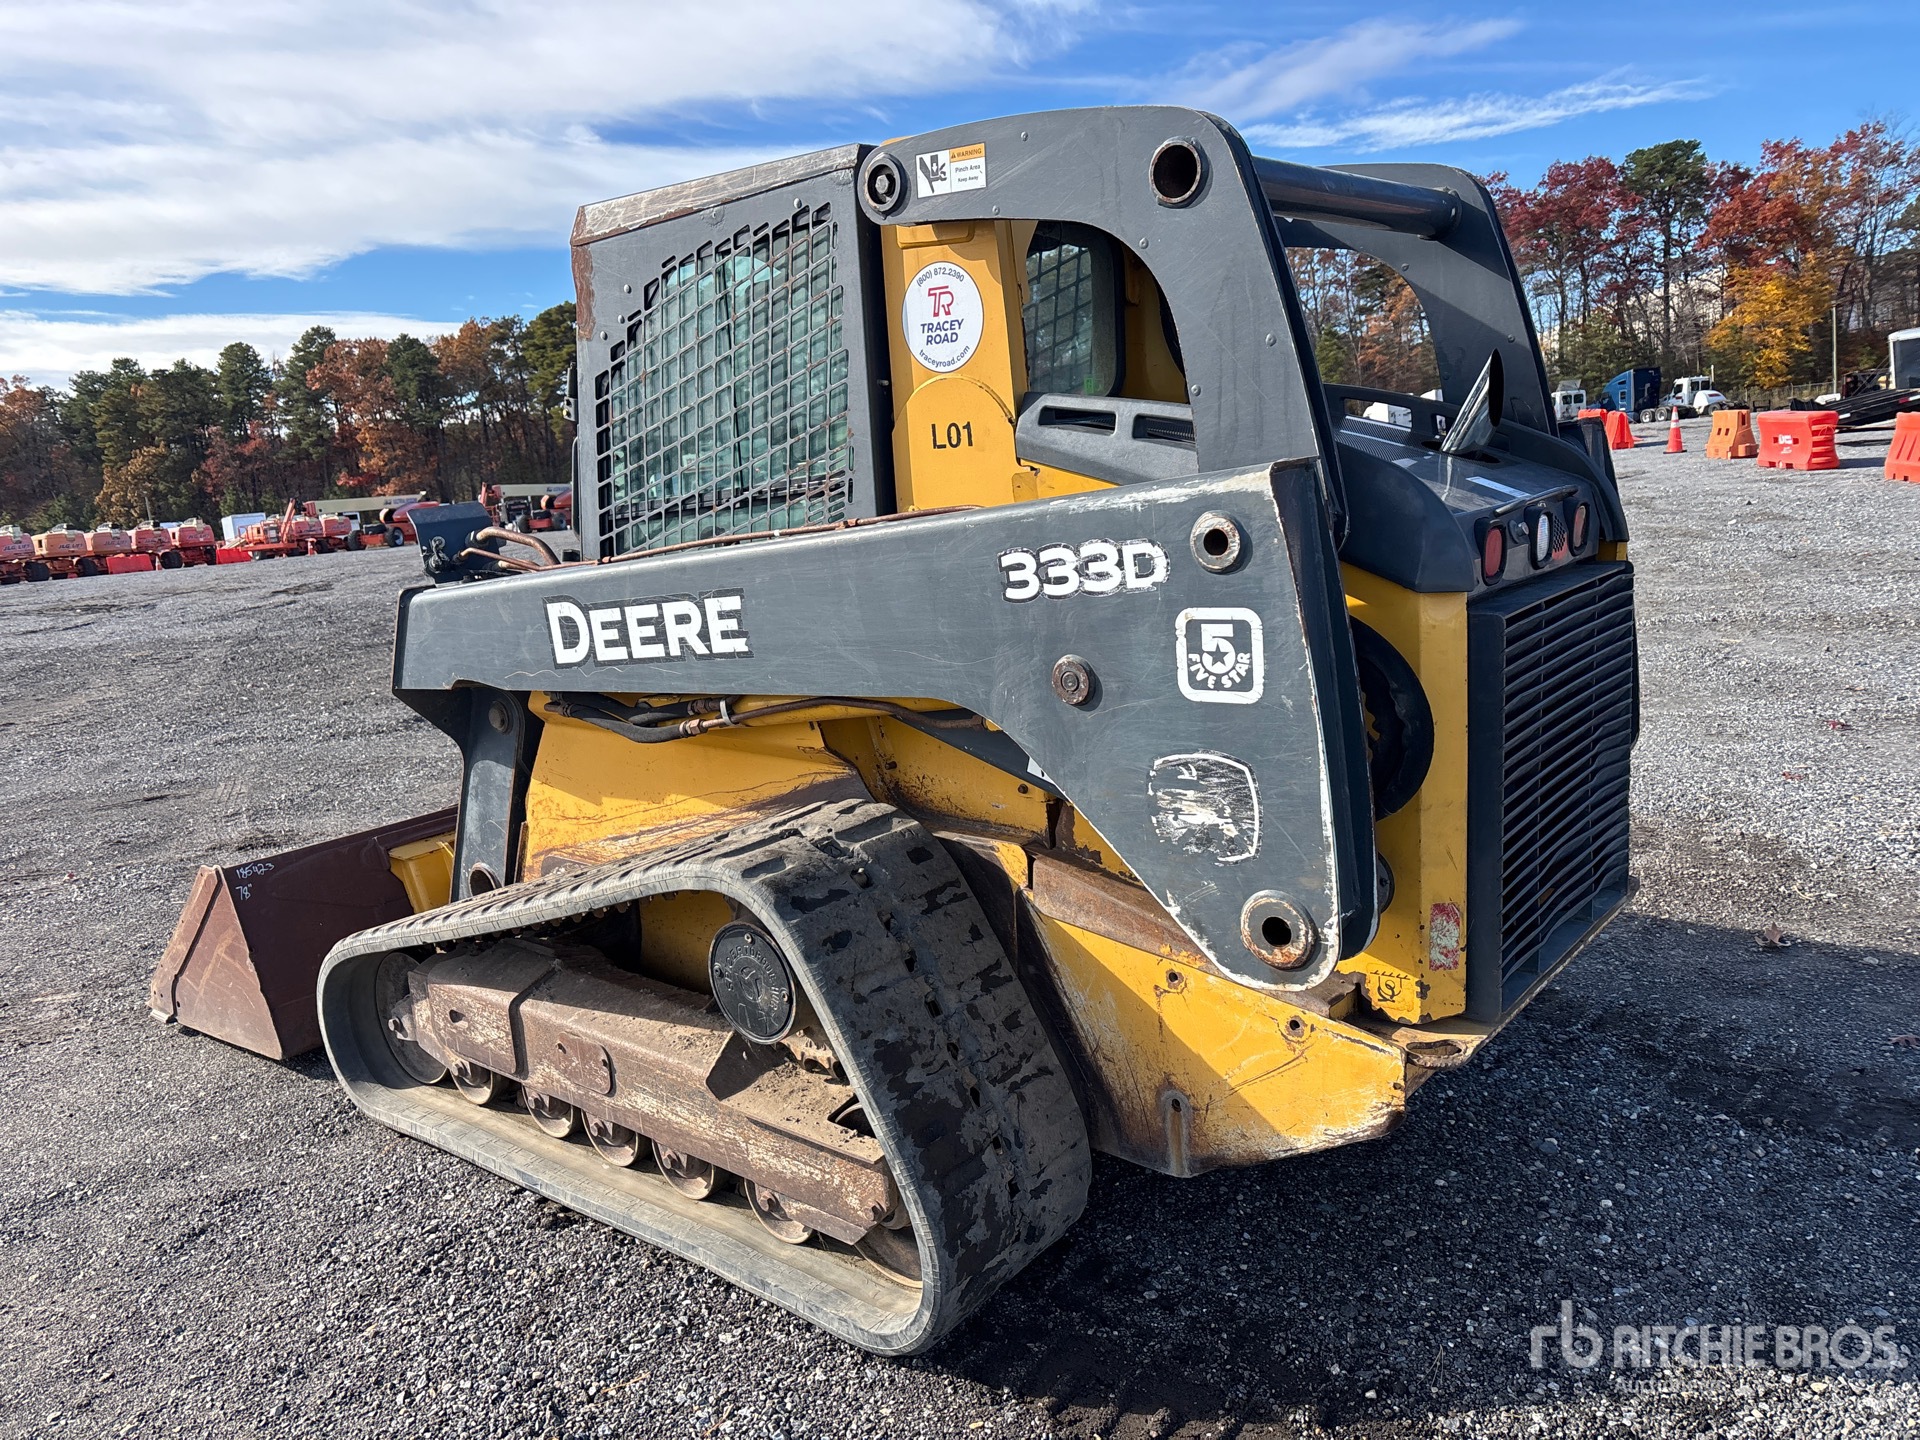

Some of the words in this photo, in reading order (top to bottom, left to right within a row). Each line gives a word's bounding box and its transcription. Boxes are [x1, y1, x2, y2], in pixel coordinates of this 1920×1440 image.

[956, 148, 982, 158] WARNING
[955, 165, 969, 173] Pinch
[916, 269, 933, 288] (800)
[933, 266, 965, 282] 872.2390
[920, 318, 965, 335] TRACEY
[925, 331, 959, 347] ROAD
[918, 344, 971, 369] traceyroad.com
[1000, 541, 1168, 601] 333D
[546, 595, 750, 665] DEERE
[1188, 653, 1217, 689] FIVE
[1221, 652, 1251, 688] STAR
